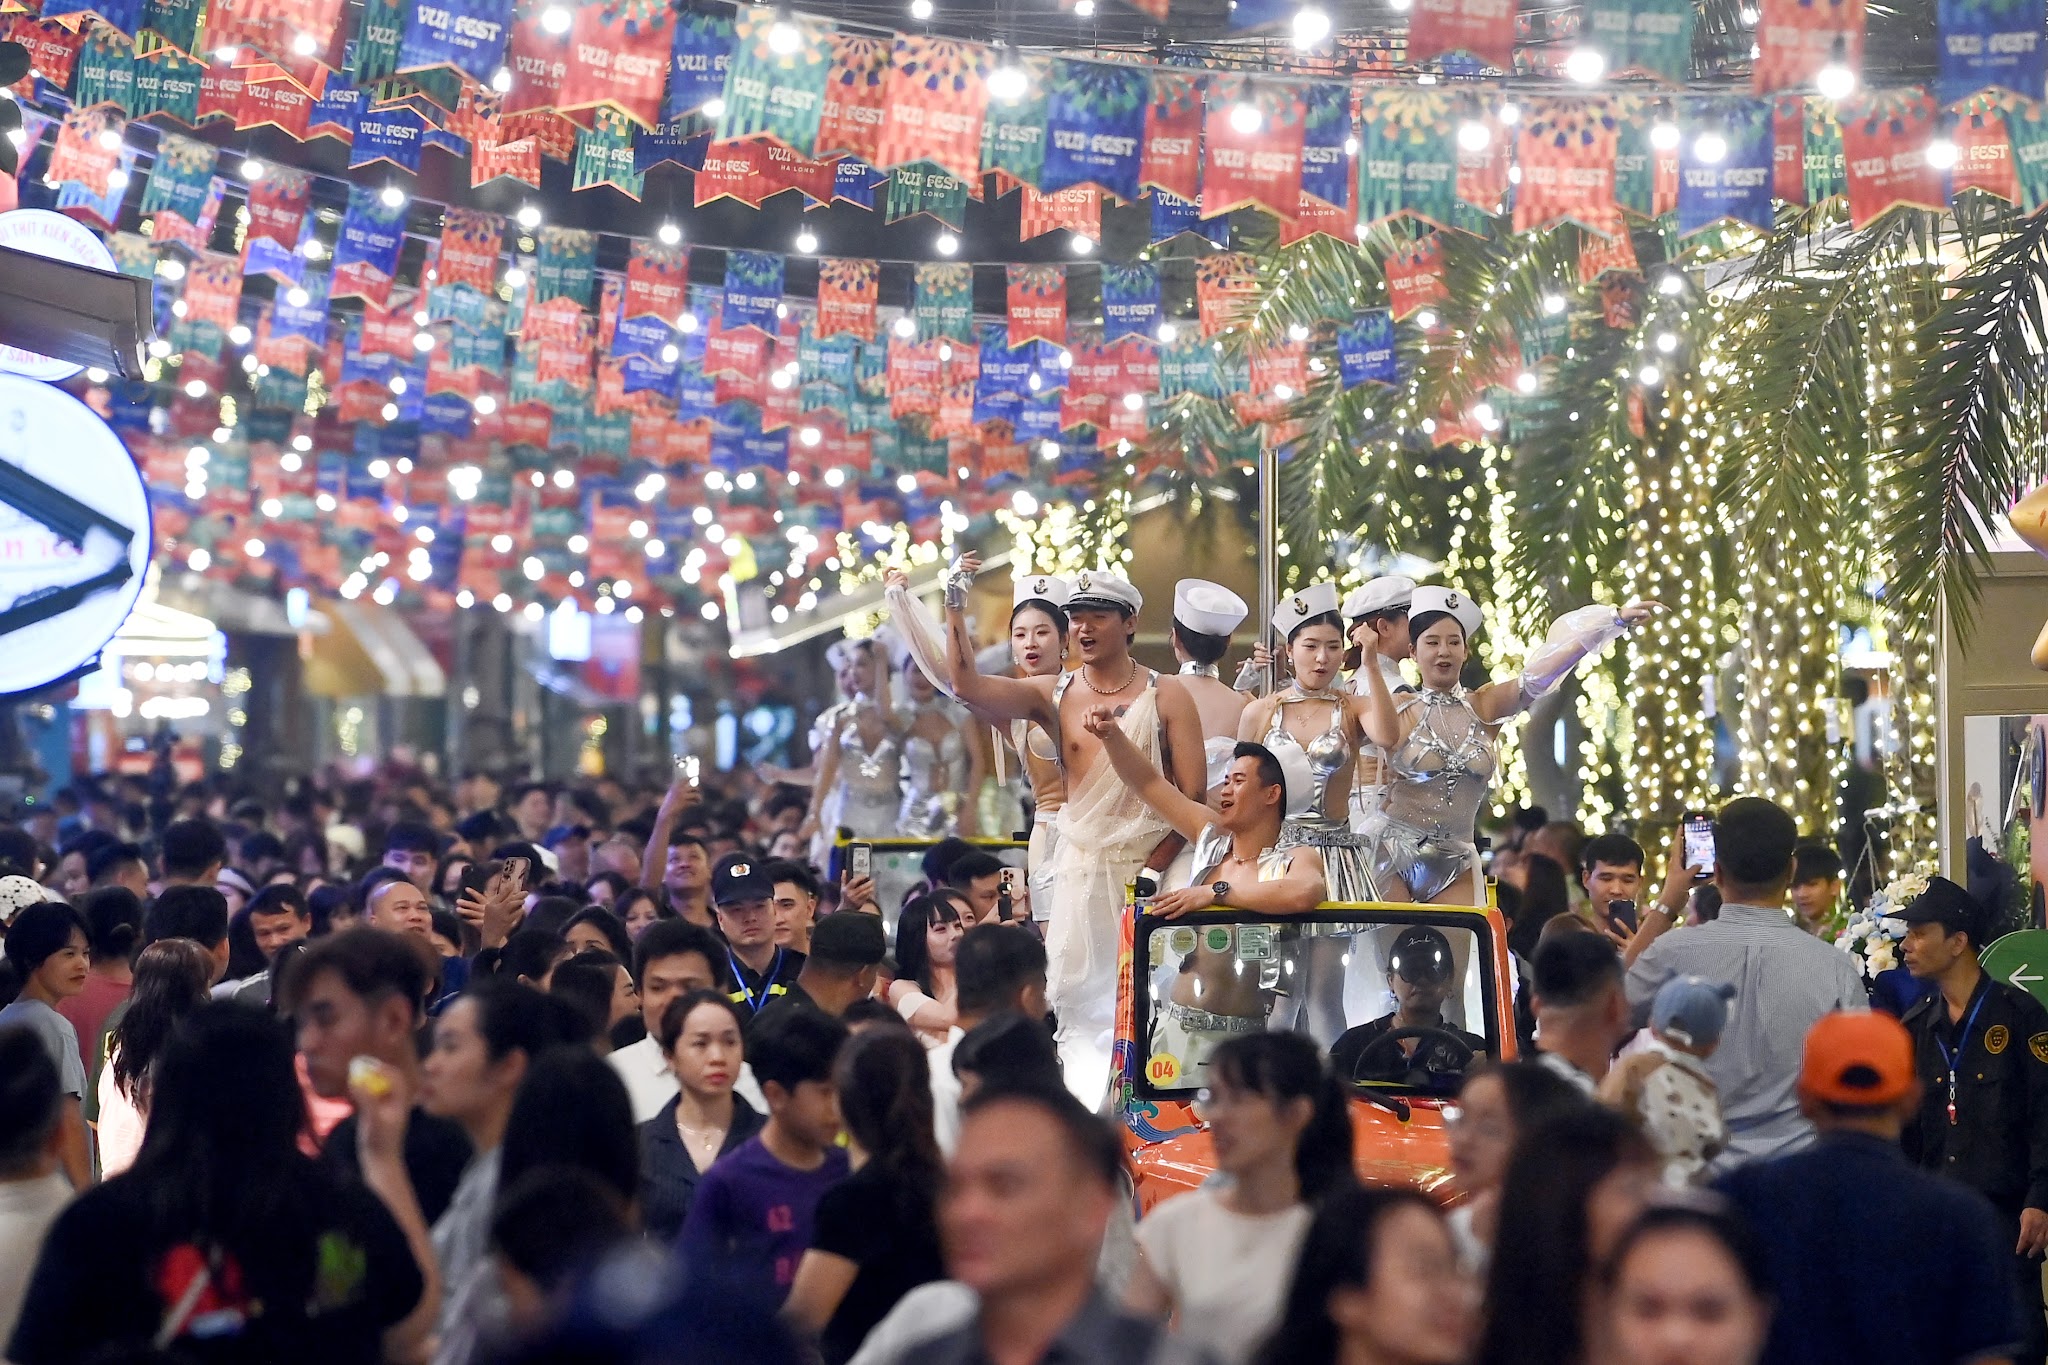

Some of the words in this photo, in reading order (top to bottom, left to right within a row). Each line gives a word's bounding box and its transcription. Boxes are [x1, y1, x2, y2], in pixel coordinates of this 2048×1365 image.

[417, 5, 452, 28] VUI
[454, 16, 502, 41] FEST
[367, 26, 397, 44] VUI
[1946, 34, 1982, 55] VUI
[1989, 31, 2039, 53] FEST
[15, 35, 37, 50] VUI
[41, 43, 72, 58] FEST
[517, 56, 545, 73] VUI
[578, 44, 609, 67] VUI
[614, 53, 660, 77] FEST
[677, 55, 707, 71] VUI
[84, 67, 105, 79] VUI
[110, 70, 132, 83] FES
[137, 78, 158, 90] VUI
[163, 80, 196, 94] FEST
[200, 78, 215, 89] UI
[220, 79, 243, 92] FES
[734, 77, 765, 99] VUI
[770, 86, 817, 110] FEST
[248, 84, 270, 99] VUI
[275, 90, 307, 105] FEST
[329, 90, 360, 103] FEST
[846, 107, 886, 125] FEST
[892, 104, 925, 125] VUI
[930, 110, 977, 134] FEST
[360, 121, 381, 135] VUI
[386, 126, 418, 139] FEST
[999, 123, 1042, 143] FEST
[1054, 130, 1088, 151] VUI
[1091, 134, 1138, 156] FEST
[1151, 137, 1193, 155] FEST
[1970, 144, 2008, 160] FEST
[585, 144, 606, 157] VUI
[611, 149, 634, 164] FES
[1213, 147, 1244, 171] VUI
[1251, 152, 1297, 172] FEST
[1302, 146, 1343, 164] FEST
[608, 162, 627, 171] LONG
[726, 160, 750, 172] FES
[794, 166, 815, 174] LONG
[838, 164, 868, 176] FEST
[1406, 162, 1450, 180] FEST
[1852, 157, 1886, 178] VUI
[897, 170, 921, 186] VUI
[927, 174, 962, 190] FEST
[1564, 168, 1609, 186] FEST
[1684, 169, 1717, 187] VUI
[1724, 168, 1768, 186] FEST
[923, 190, 945, 199] LONG
[1058, 190, 1095, 204] FEST
[652, 285, 680, 298] FEST
[750, 297, 778, 309] FEST
[846, 302, 871, 315] FEST
[1106, 304, 1127, 316] VUI
[1129, 304, 1157, 315] FEST
[941, 307, 967, 318] FEST
[1011, 307, 1031, 318] VUI
[1034, 307, 1061, 319] FEST
[1364, 350, 1391, 363] FEST
[1003, 363, 1030, 374] FEST
[1152, 1060, 1174, 1079] 04
